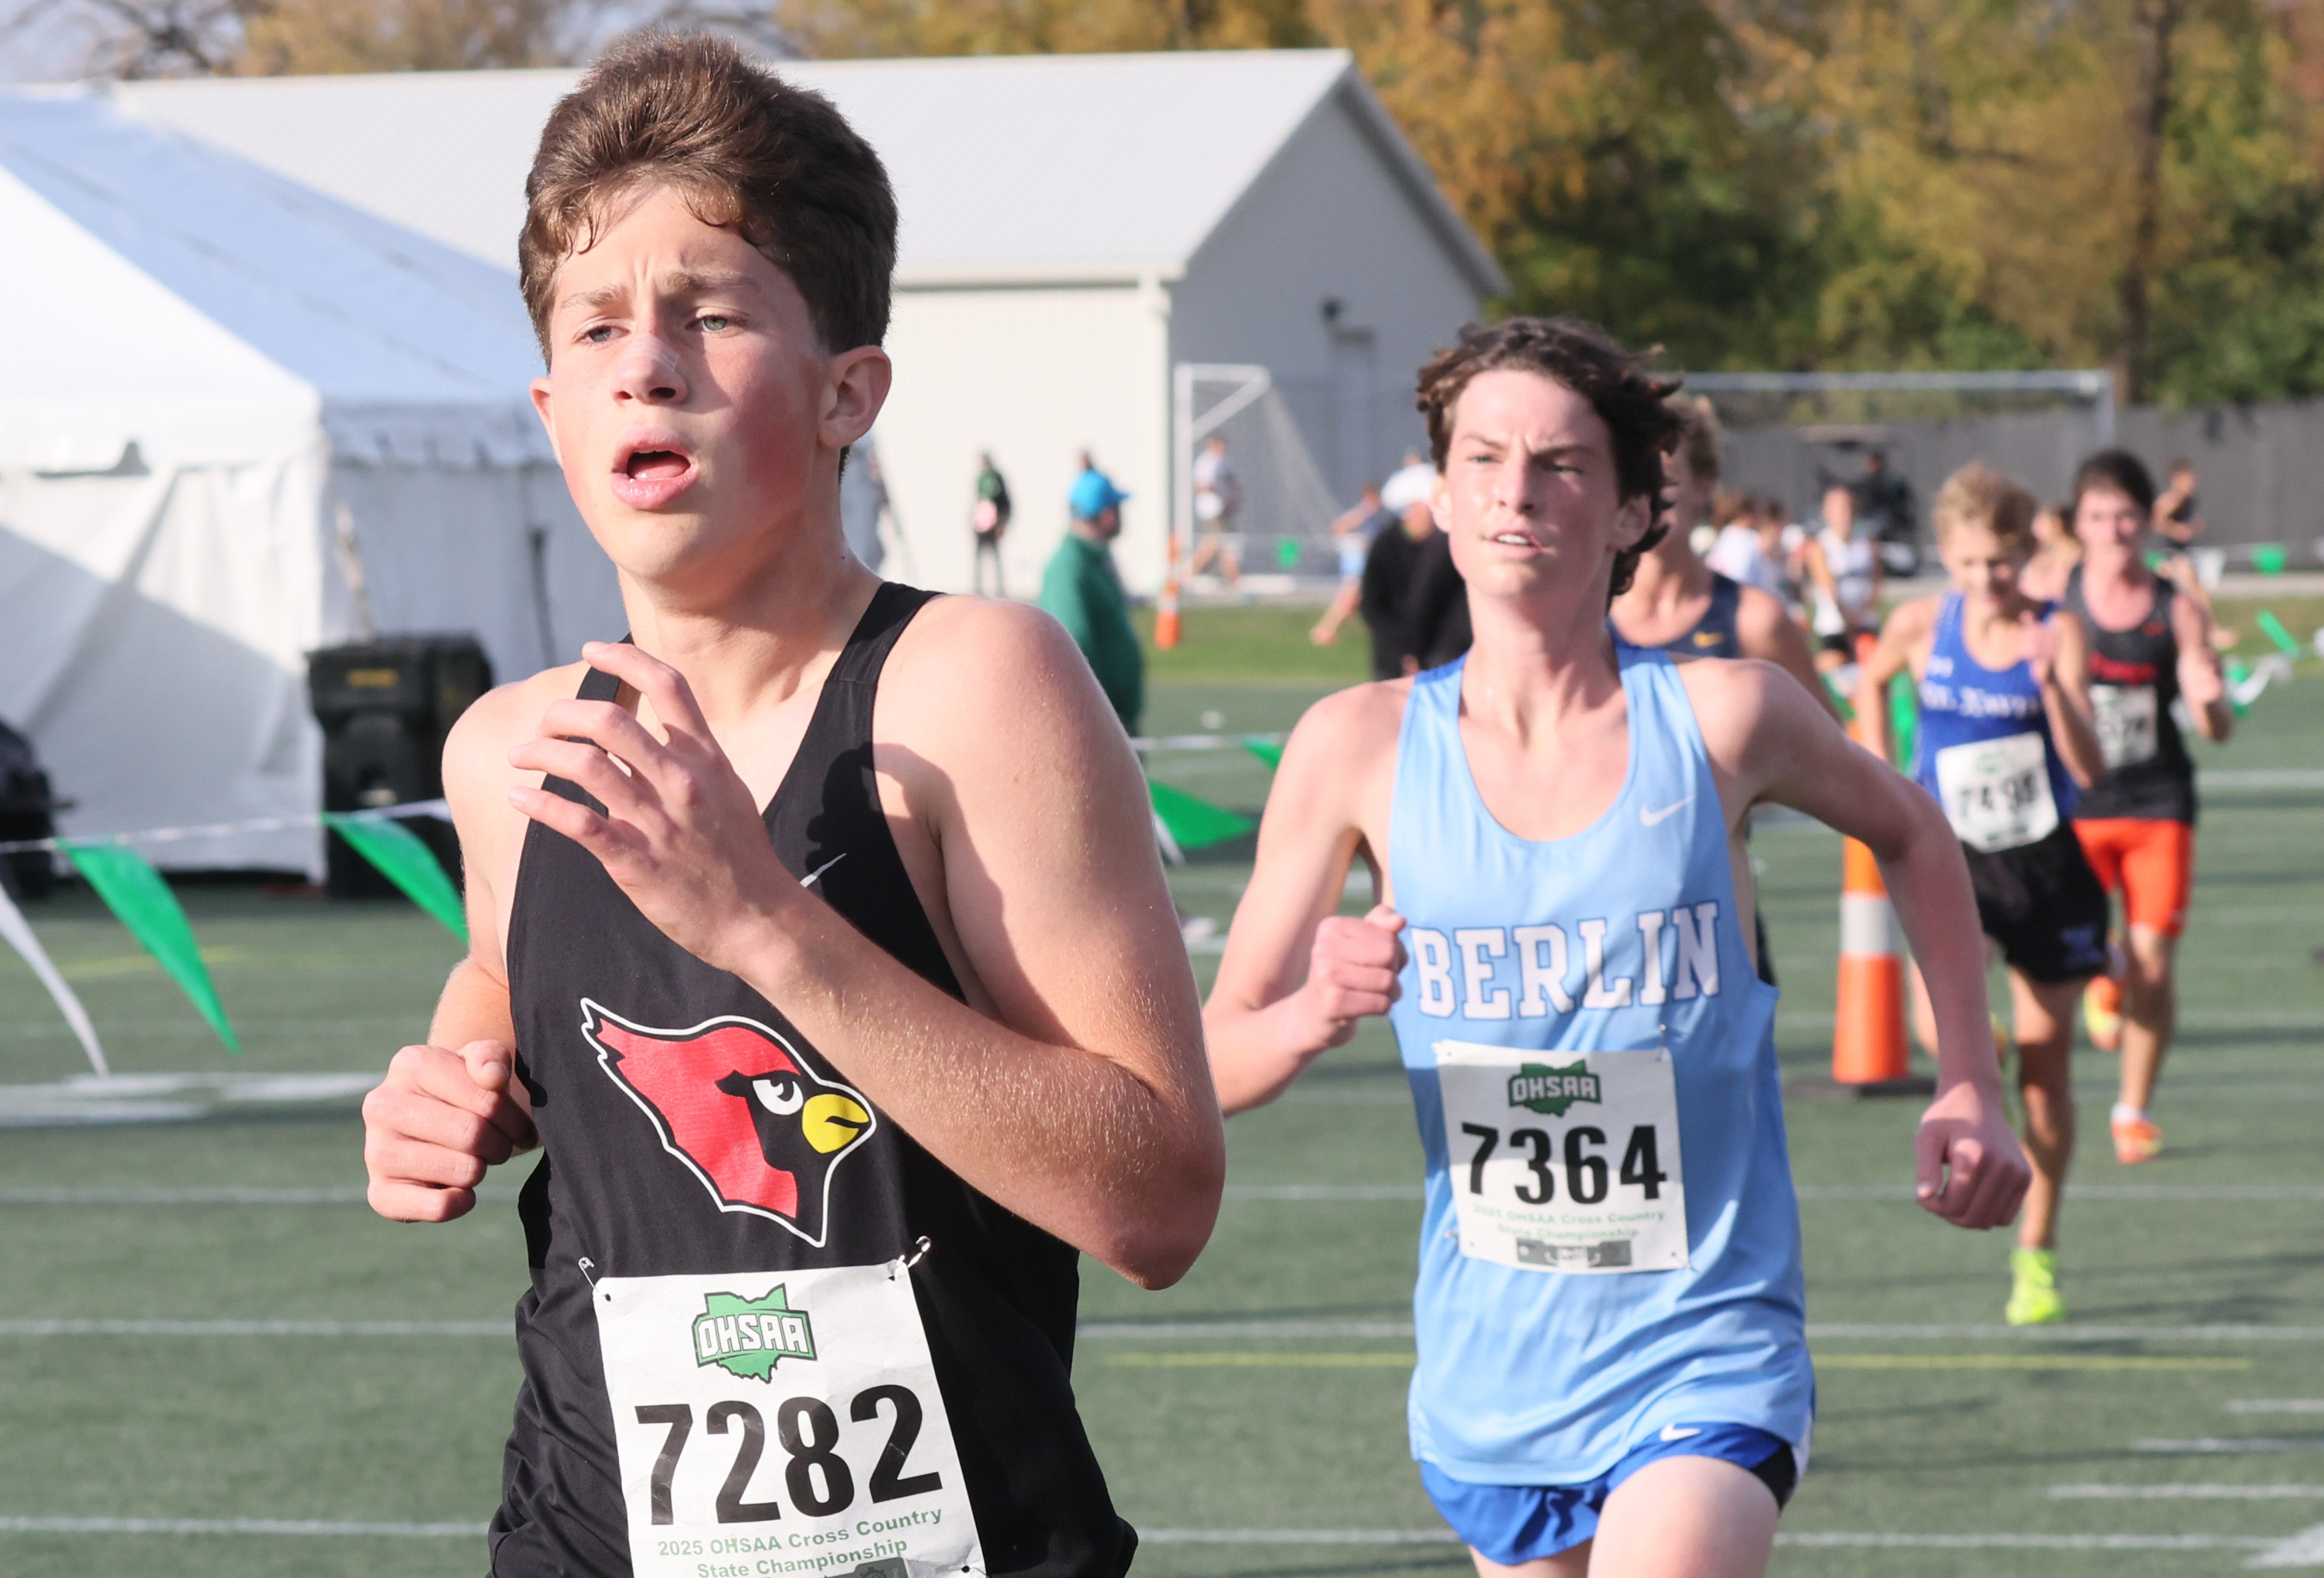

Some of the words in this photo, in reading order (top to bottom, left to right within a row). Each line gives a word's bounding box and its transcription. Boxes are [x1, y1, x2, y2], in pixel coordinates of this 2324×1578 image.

[1411, 901, 1720, 1019] BERLIN
[1512, 1074, 1597, 1103] OHSAA
[1461, 1122, 1666, 1204] 7364
[1498, 1224, 1530, 1236] State
[1538, 1226, 1639, 1240] Championship
[1507, 1211, 1556, 1224] OHSAA
[1561, 1212, 1603, 1224] Cross
[1607, 1210, 1666, 1222] Country
[696, 1312, 811, 1360] OHSAA
[634, 1384, 943, 1525] 7282
[658, 1541, 703, 1555] 2025
[710, 1536, 782, 1554] OHSAA
[788, 1529, 849, 1548] Cross
[856, 1509, 941, 1536] Country
[697, 1563, 749, 1578] State
[756, 1539, 907, 1574] Championship
